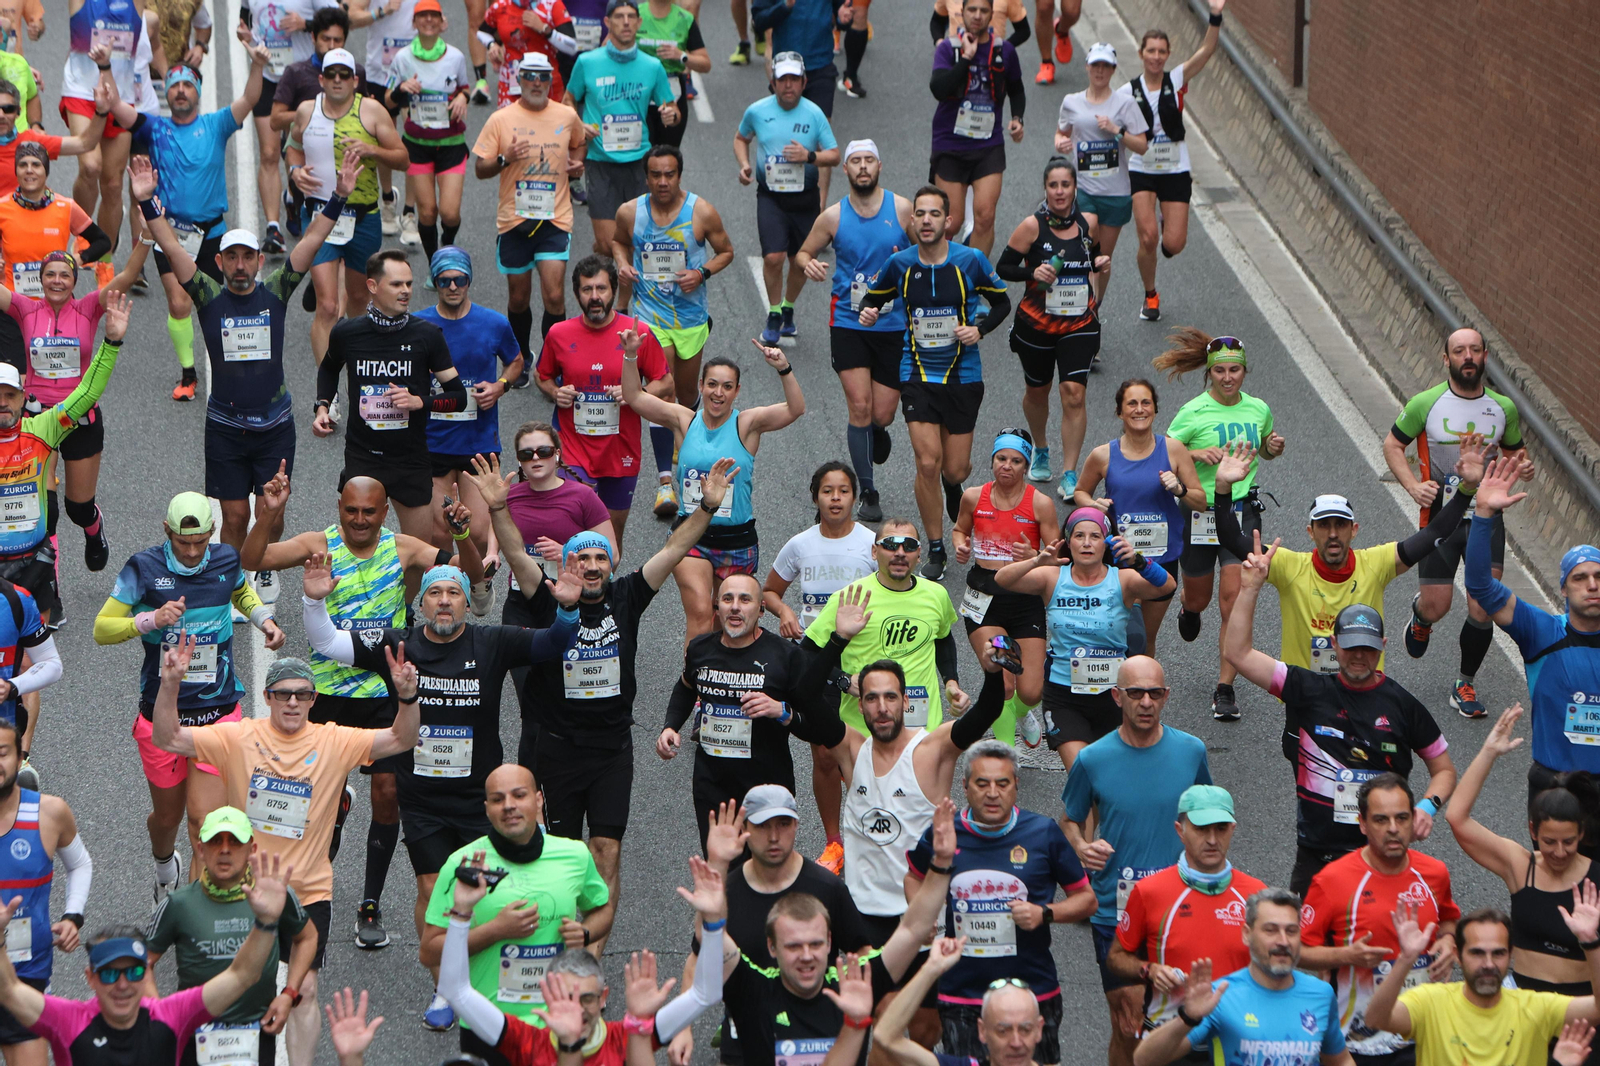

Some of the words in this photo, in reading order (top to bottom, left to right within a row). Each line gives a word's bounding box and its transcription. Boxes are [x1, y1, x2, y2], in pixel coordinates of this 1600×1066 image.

[604, 82, 643, 102] VILNIUS
[793, 123, 810, 134] RC
[656, 243, 680, 251] ZURICH
[1061, 276, 1084, 284] ZURICH
[926, 308, 952, 316] ZURICH
[357, 360, 411, 376] HITACHI
[4, 485, 33, 494] ZURICH
[4, 502, 23, 510] 9776
[1134, 514, 1163, 522] ZURICH
[804, 569, 862, 581] BIANCA
[1056, 596, 1102, 609] nerja
[356, 620, 387, 628] ZURICH
[582, 648, 614, 658] ZURICH
[582, 667, 602, 675] 9657
[1087, 664, 1110, 672] 10149
[708, 670, 765, 688] PRESIDIARIOS
[419, 677, 479, 692] PRESIDIARIOS
[702, 689, 725, 697] PACO
[418, 697, 444, 705] PACO
[454, 696, 480, 706] IBÓN
[198, 710, 220, 724] MAX
[1585, 712, 1600, 720] 106
[434, 728, 467, 736] ZURICH
[713, 725, 732, 733] 8527
[702, 736, 720, 745] MERINO
[721, 738, 748, 746] PASCUAL
[432, 745, 453, 753] 8528
[1357, 773, 1377, 781] ZUR
[271, 781, 305, 795] ZURICH
[267, 798, 289, 810] 8752
[268, 814, 282, 823] Alan
[870, 819, 892, 834] AR
[970, 921, 996, 930] 10449
[970, 936, 988, 944] Victor
[521, 967, 543, 976] 8679
[800, 1044, 831, 1052] ZURIC
